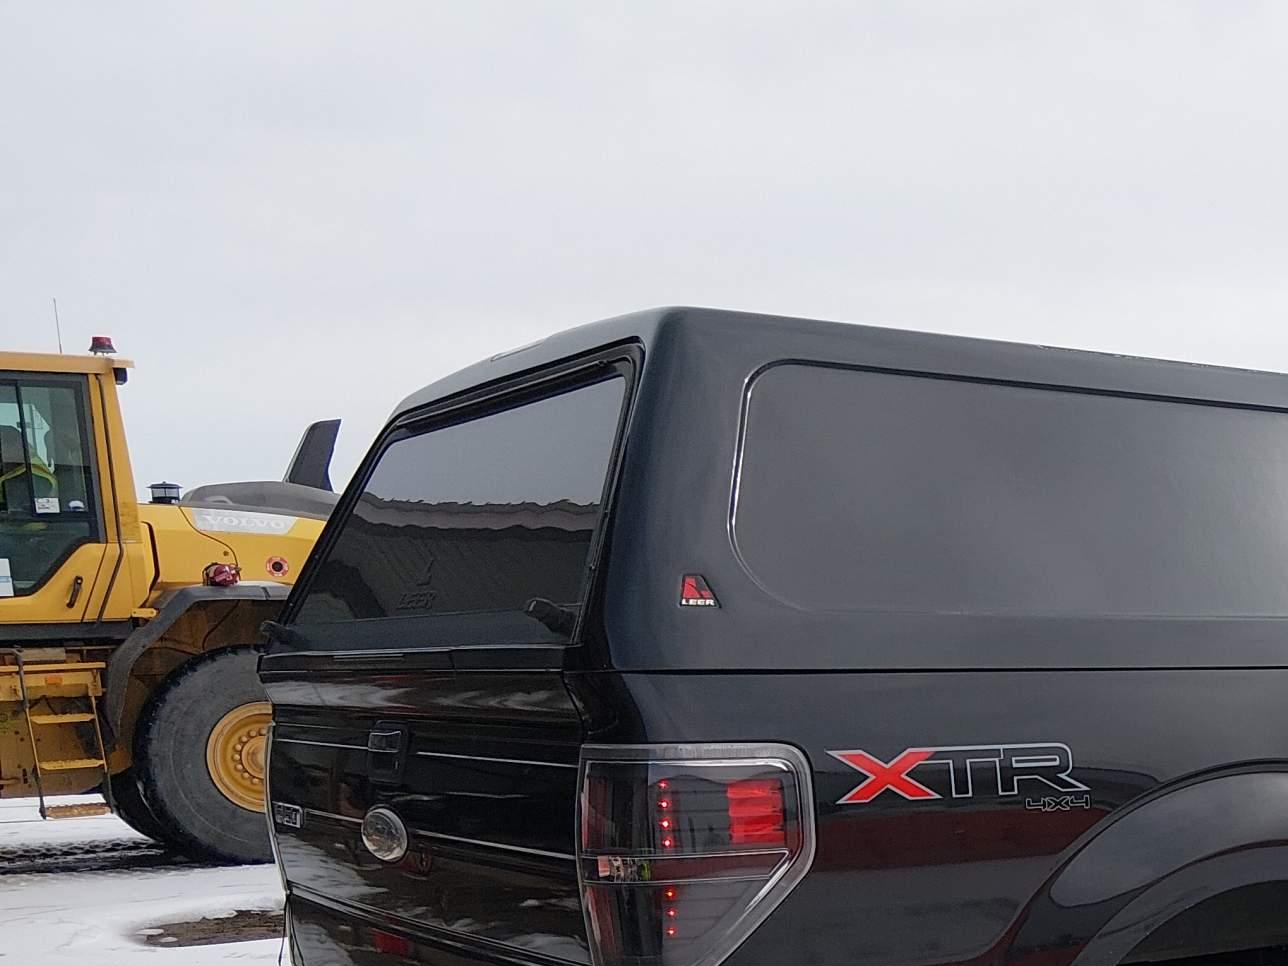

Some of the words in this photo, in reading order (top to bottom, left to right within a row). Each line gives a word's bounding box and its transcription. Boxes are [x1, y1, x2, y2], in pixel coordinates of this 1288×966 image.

[199, 513, 285, 529] VOLVO
[681, 598, 715, 606] LEER
[824, 742, 1092, 804] XTR
